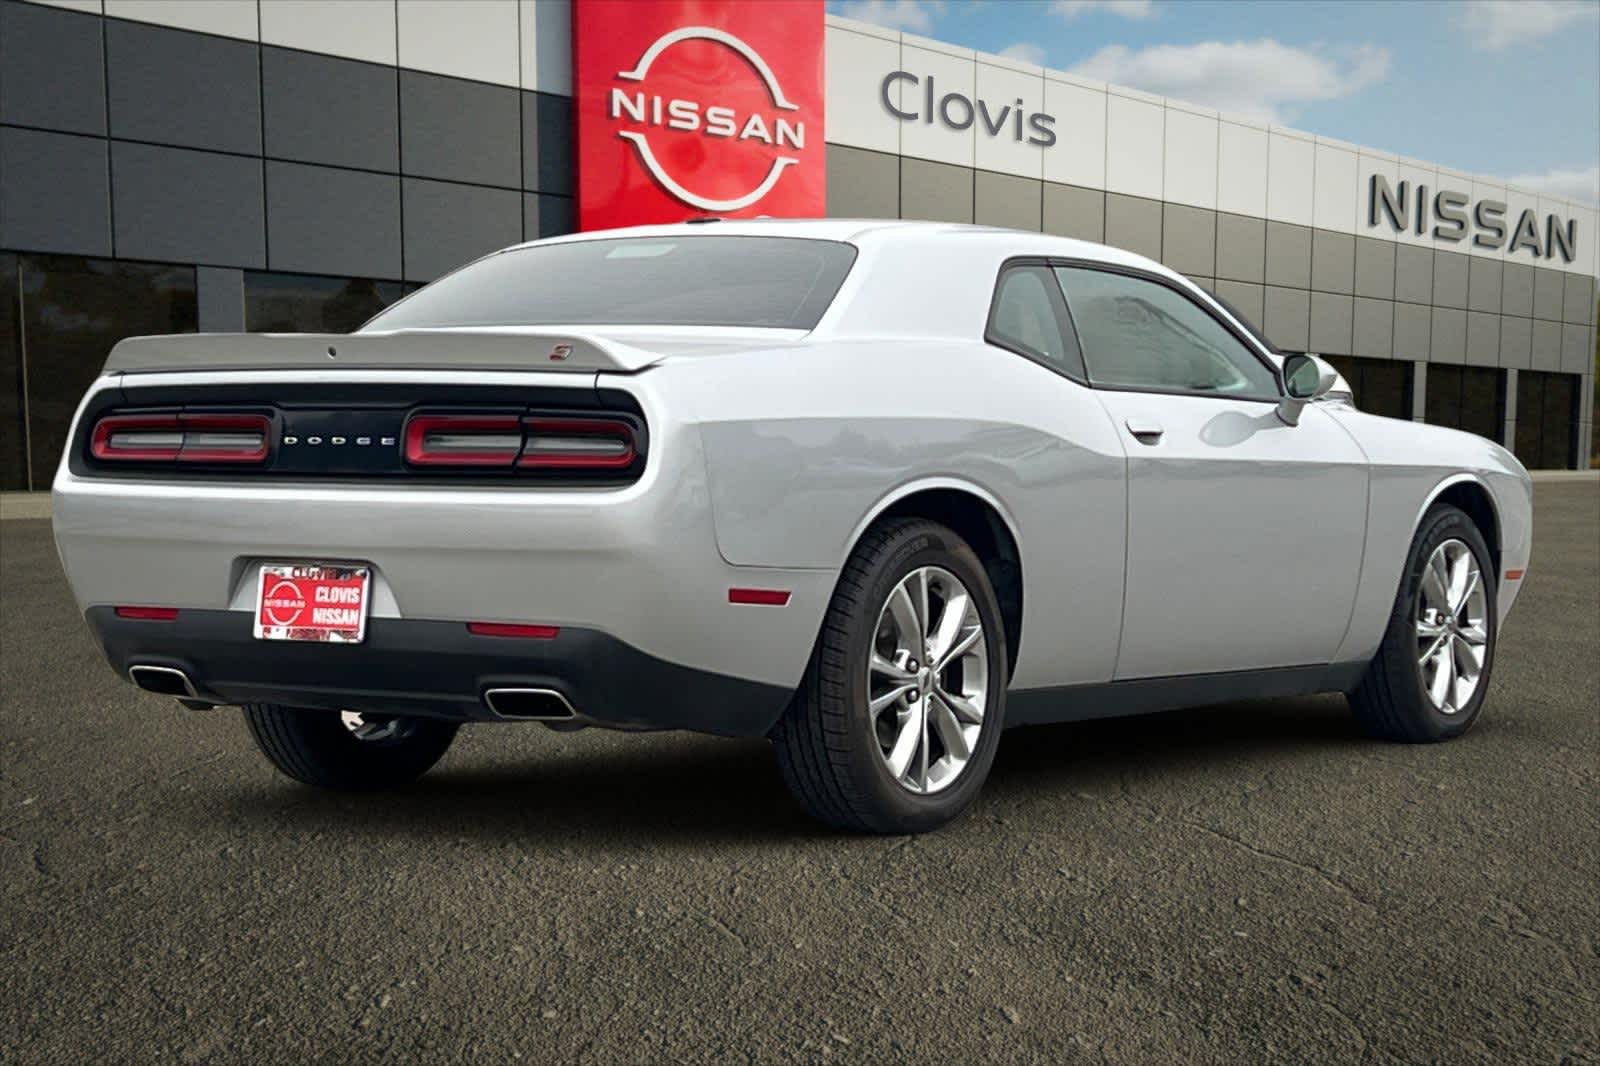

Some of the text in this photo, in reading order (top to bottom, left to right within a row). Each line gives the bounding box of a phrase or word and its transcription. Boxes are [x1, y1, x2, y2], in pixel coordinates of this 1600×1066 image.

[881, 70, 1057, 147] Clovis
[610, 87, 804, 148] NISSAN
[1368, 173, 1578, 263] NISSAN
[284, 436, 396, 446] DODGE
[315, 586, 360, 603] CLOVIS
[263, 599, 305, 608] NISSAN
[312, 608, 359, 625] NISSAN
